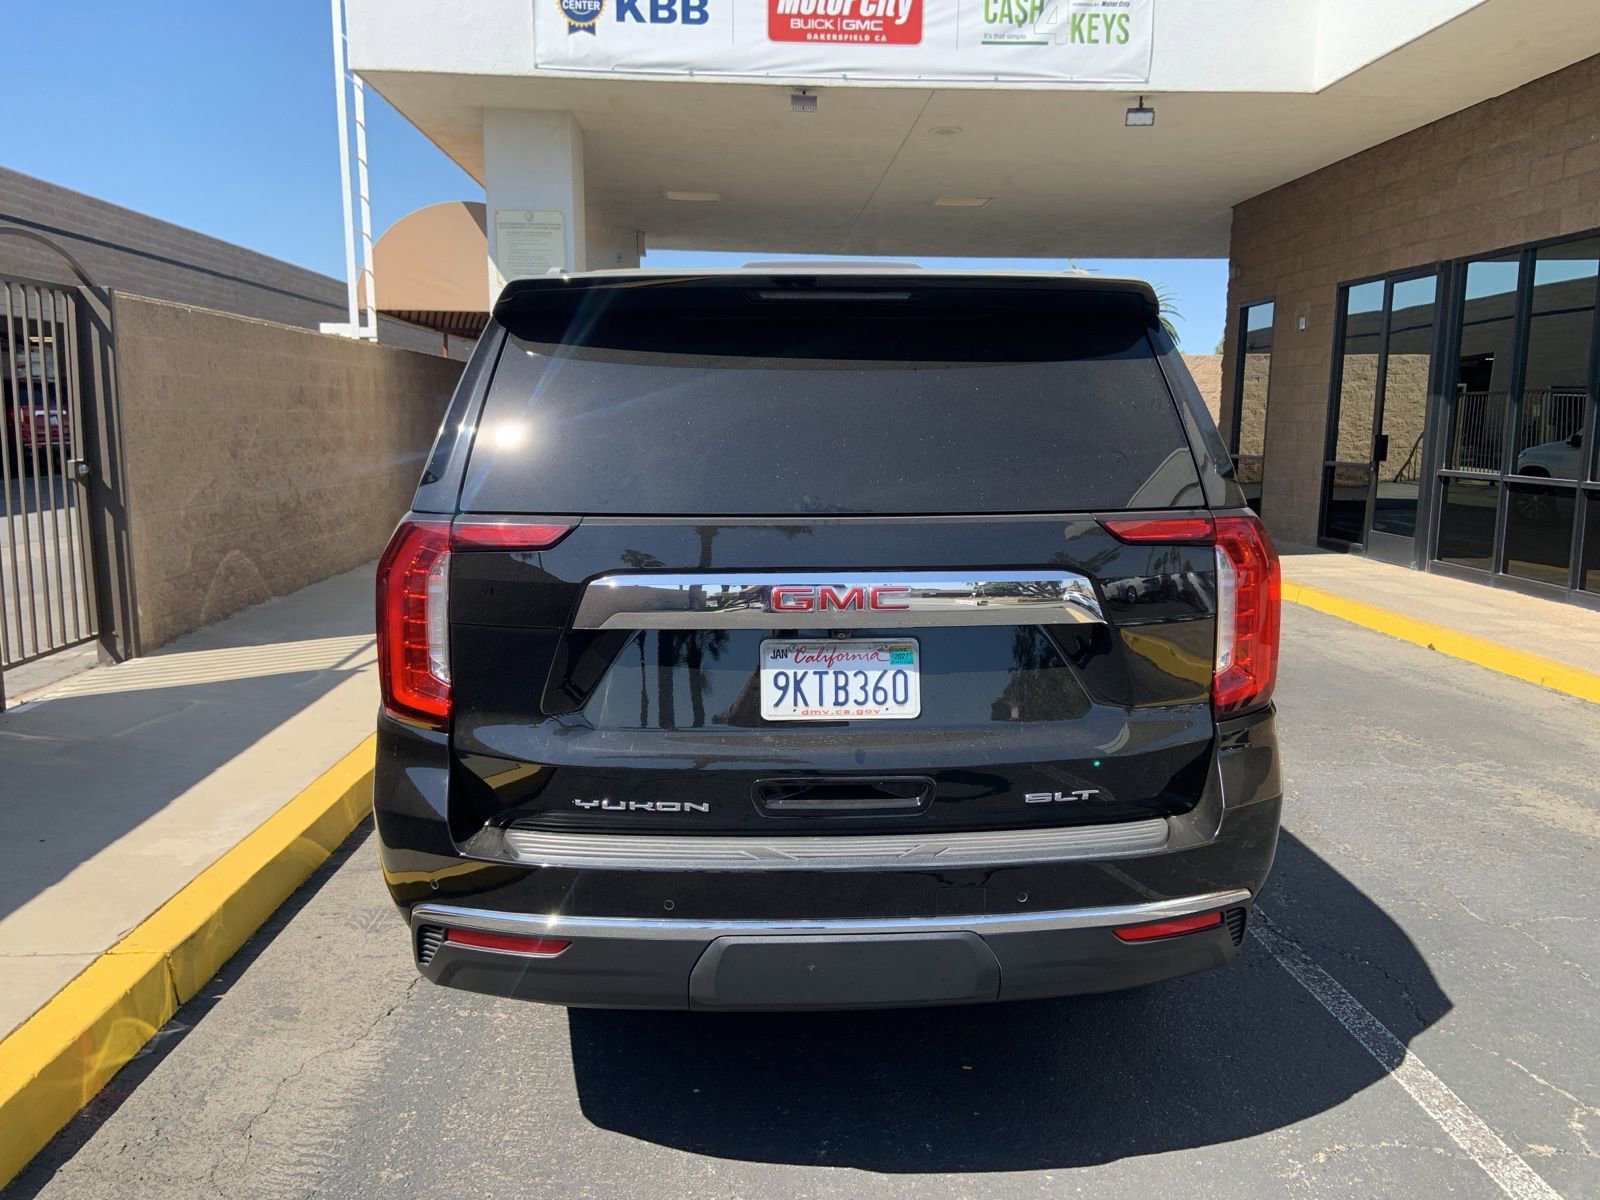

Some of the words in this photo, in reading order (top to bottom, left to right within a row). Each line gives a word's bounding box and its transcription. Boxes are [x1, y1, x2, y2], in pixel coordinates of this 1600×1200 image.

[562, 0, 601, 10] CENTER
[616, 0, 710, 25] KBB
[790, 18, 834, 29] BUICK
[842, 19, 884, 31] GMC
[1071, 12, 1130, 45] KEYS
[806, 33, 870, 41] BAKERSFIELD
[874, 34, 888, 42] CA
[771, 586, 911, 612] GMC
[770, 649, 788, 660] JAN
[793, 645, 889, 668] California
[773, 669, 909, 708] 9KTB360
[801, 708, 881, 716] dmv.ca.gov
[1025, 789, 1099, 803] SLT
[573, 798, 710, 813] YUKON
